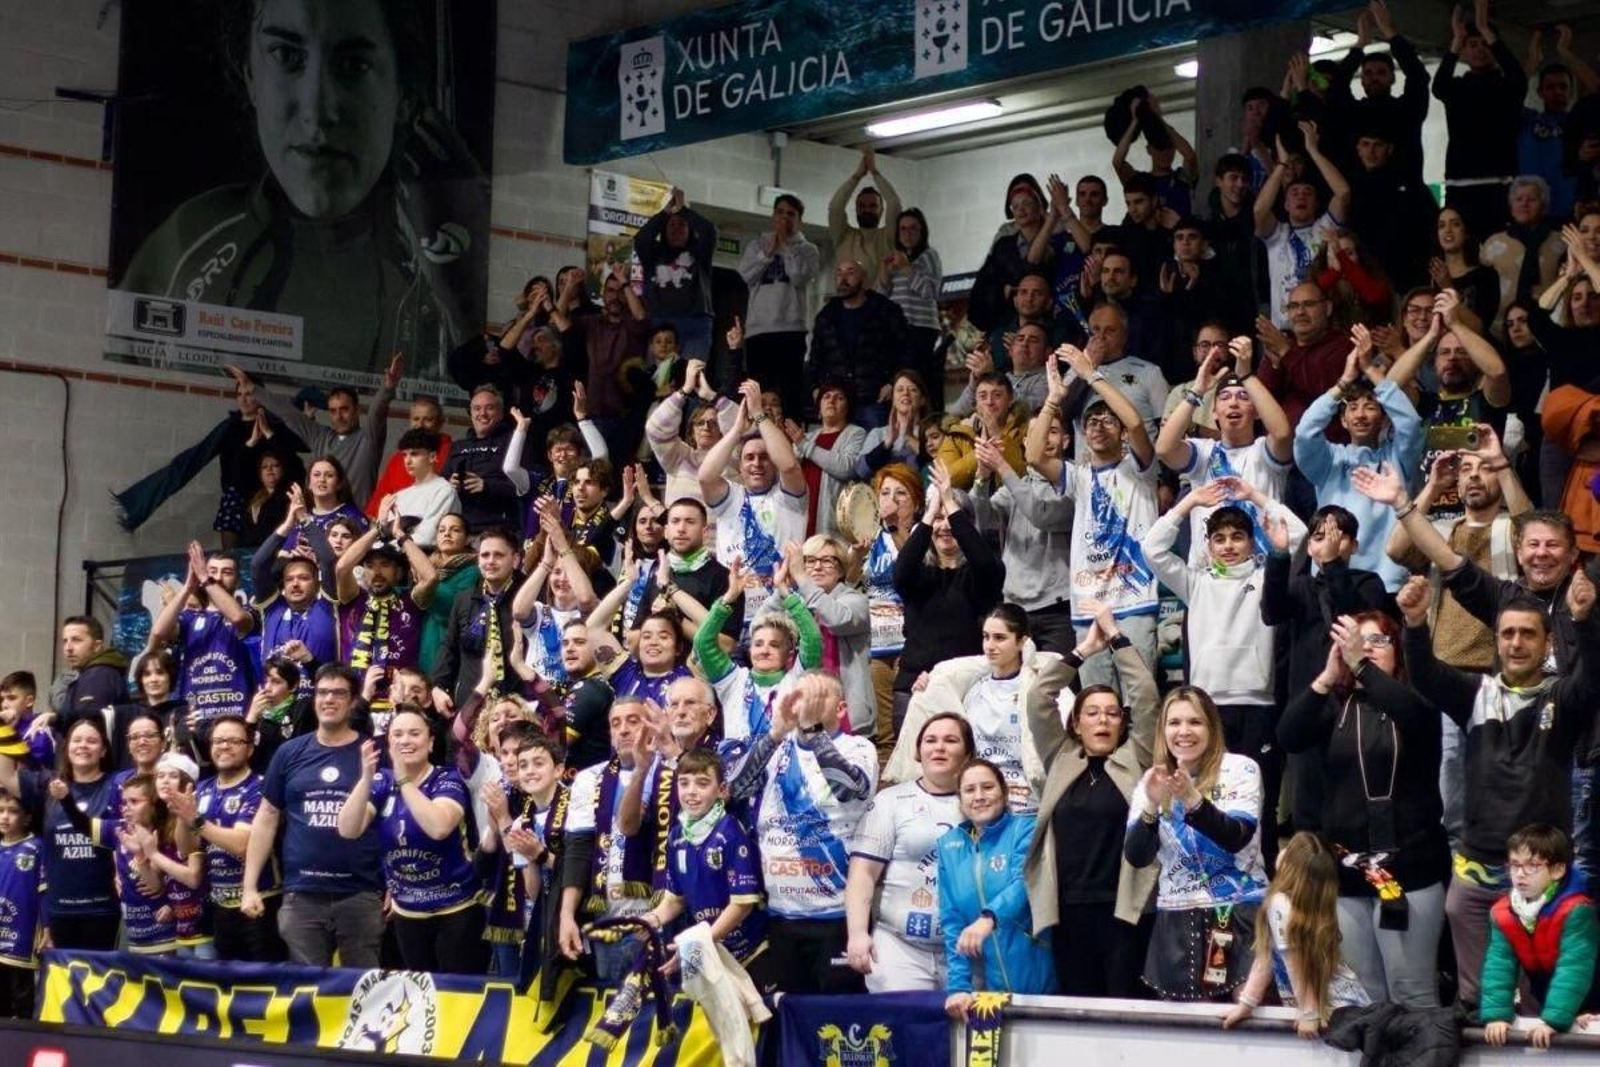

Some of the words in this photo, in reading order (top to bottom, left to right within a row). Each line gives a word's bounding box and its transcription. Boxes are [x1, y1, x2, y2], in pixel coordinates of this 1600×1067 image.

[980, 10, 1026, 56] DE
[1038, 0, 1192, 43] GALICIA
[677, 19, 782, 75] XUNTA
[673, 79, 712, 119] DE
[721, 50, 852, 109] GALICIA
[257, 361, 288, 374] VELA
[417, 382, 459, 396] MUNDO
[197, 691, 245, 705] CASTRO
[304, 801, 342, 814] MARE
[655, 769, 674, 871] BALONM
[55, 833, 93, 846] MARE
[62, 846, 97, 860] AZUL
[768, 862, 834, 877] CASTRO
[506, 866, 517, 912] BAL
